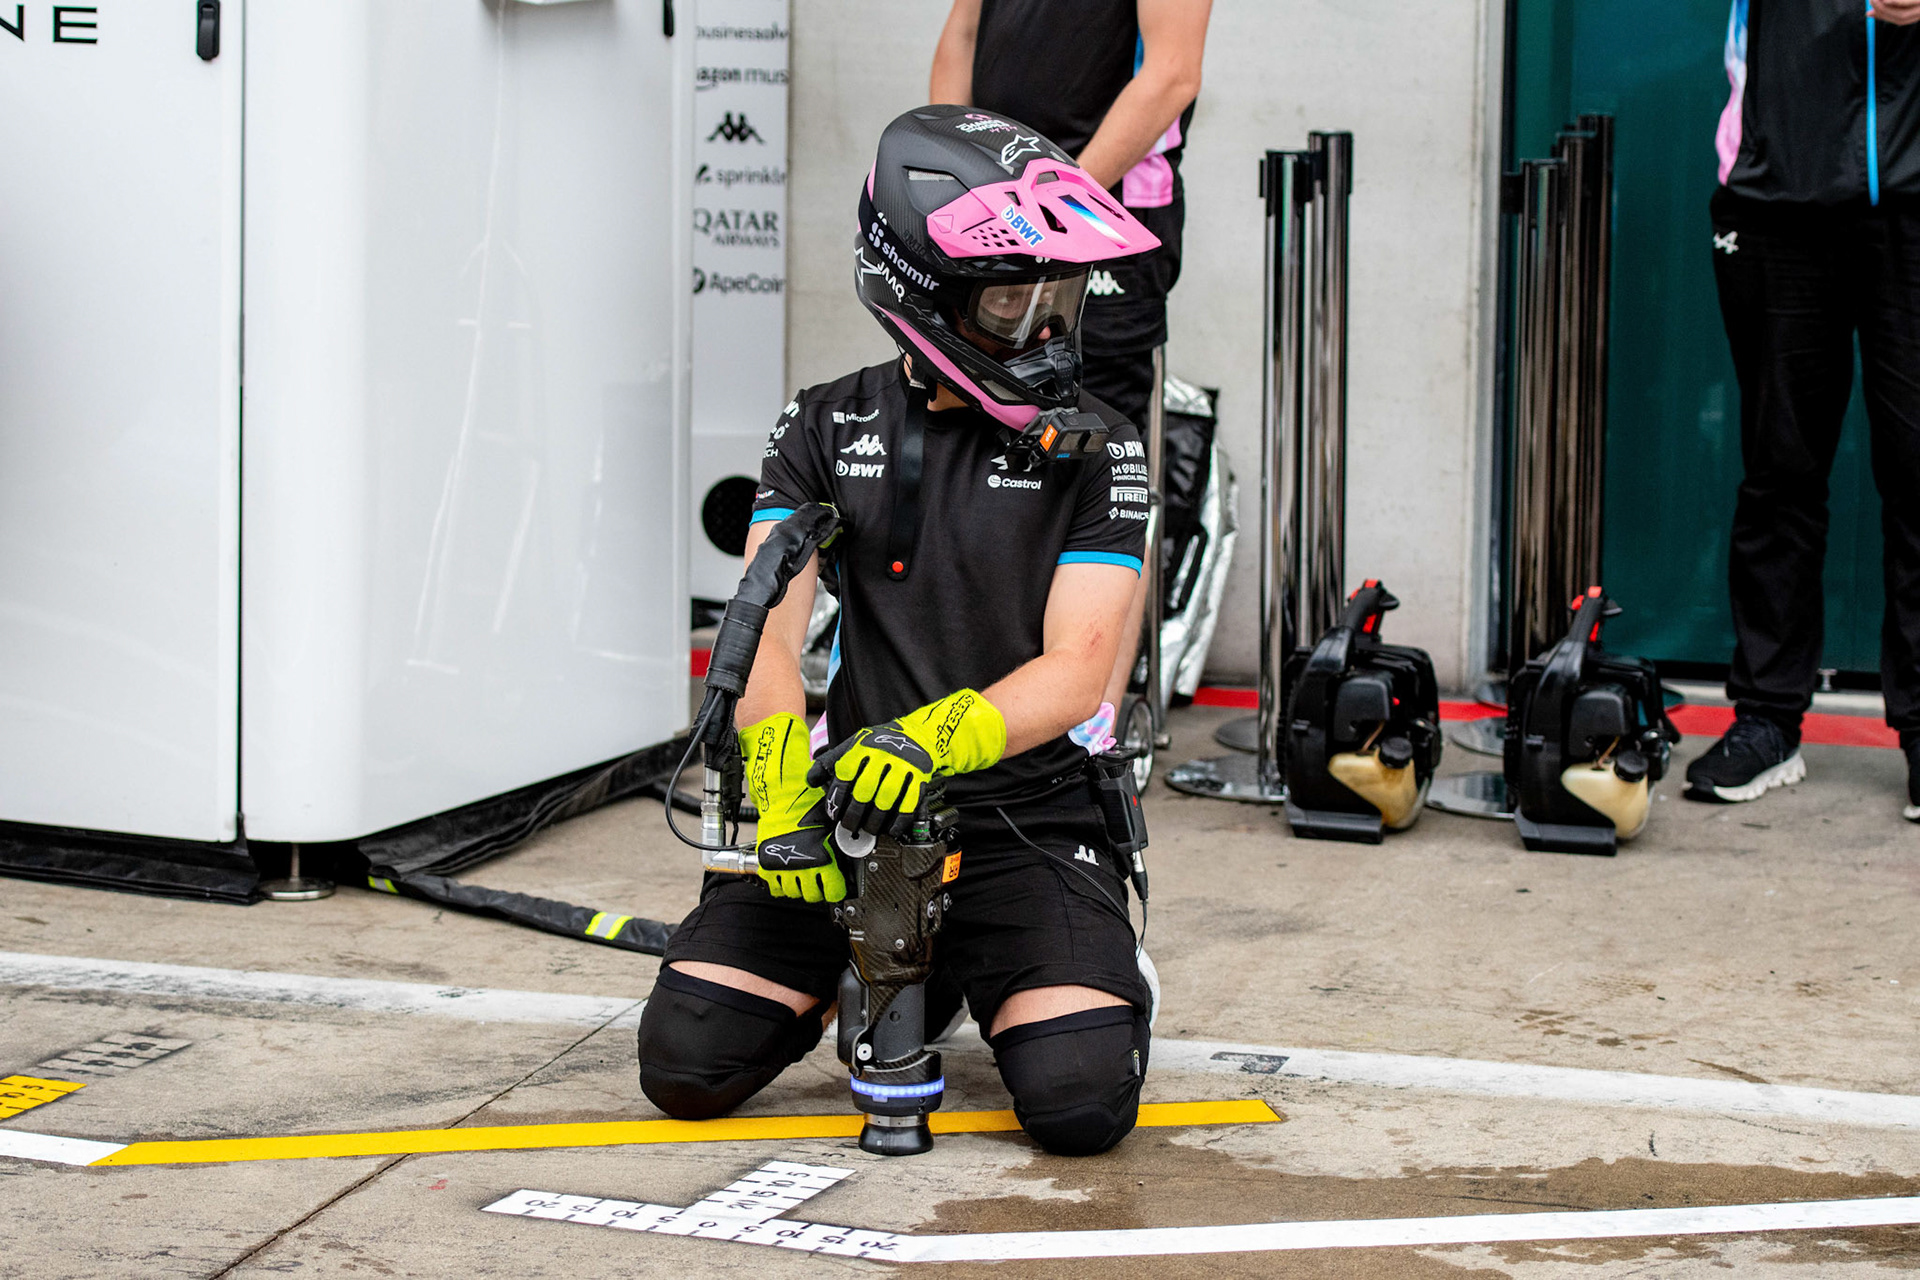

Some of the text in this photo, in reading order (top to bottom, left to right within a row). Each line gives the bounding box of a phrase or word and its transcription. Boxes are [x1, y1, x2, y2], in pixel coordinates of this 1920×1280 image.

[693, 208, 778, 234] QATAR
[1010, 214, 1044, 246] BWT
[881, 241, 940, 291] shamir
[849, 463, 885, 478] BWT
[1001, 477, 1042, 490] Castrol
[525, 1199, 561, 1209] 20
[569, 1204, 598, 1214] 15
[611, 1209, 639, 1219] 10
[656, 1215, 679, 1224] 5
[698, 1221, 718, 1229] 0
[740, 1225, 763, 1233] 5
[776, 1229, 805, 1239] 10
[818, 1235, 846, 1245] 15
